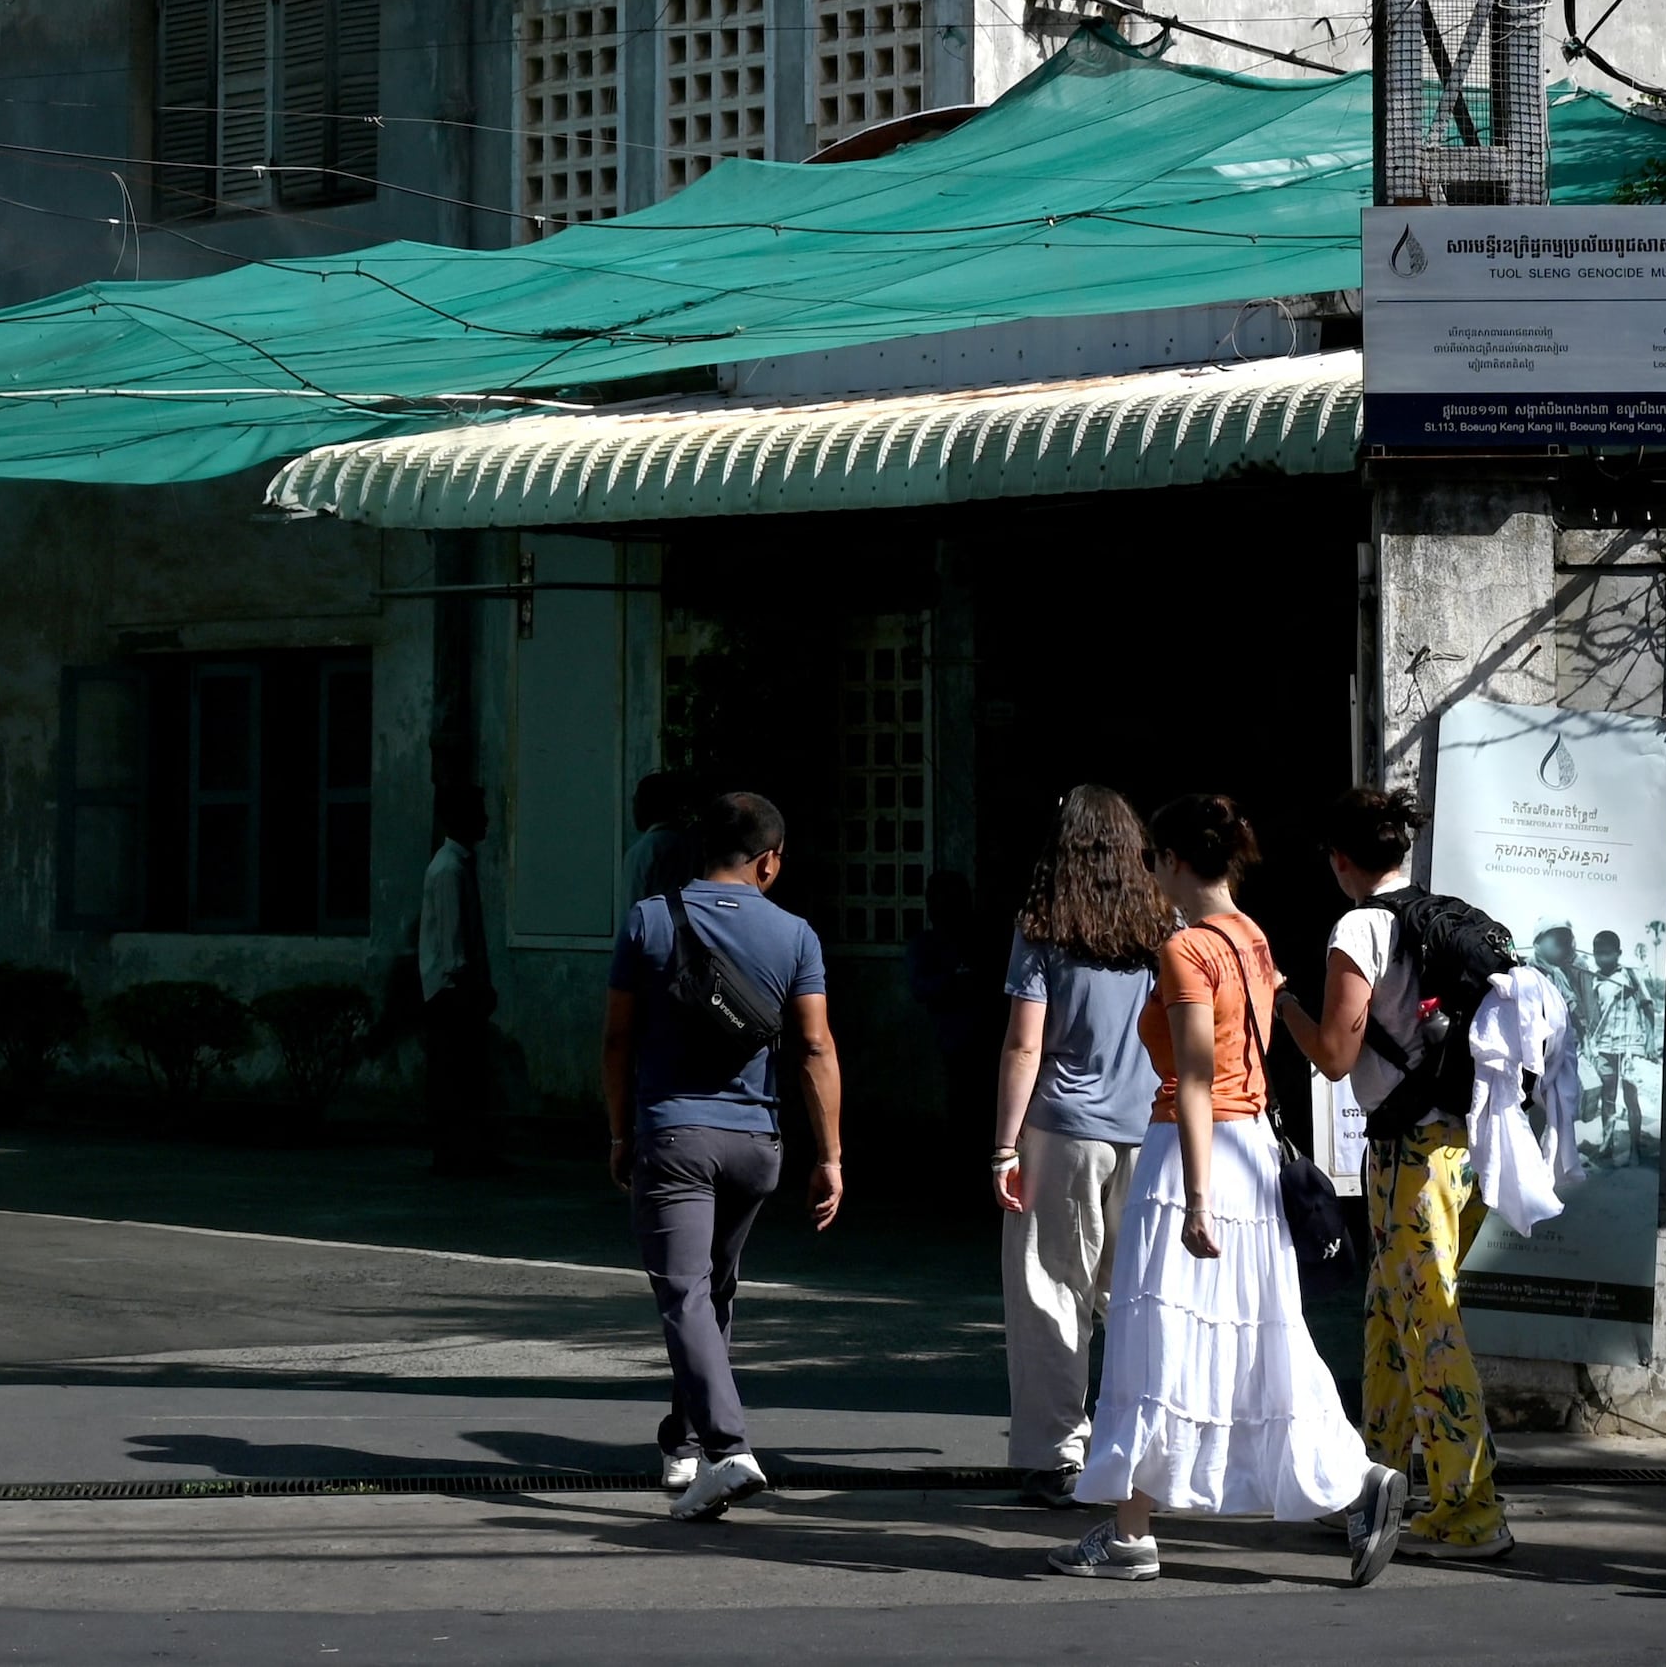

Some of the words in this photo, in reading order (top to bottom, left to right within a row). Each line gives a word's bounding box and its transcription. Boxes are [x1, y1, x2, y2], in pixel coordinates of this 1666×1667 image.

[1489, 268, 1522, 279] TUOL
[1528, 268, 1571, 279] SLENG
[1577, 267, 1644, 278] GENOCIDE
[1424, 421, 1458, 433] St.113,
[1460, 421, 1497, 434] Boeung
[1499, 421, 1525, 434] Keng
[1527, 421, 1553, 434] Kang
[1569, 421, 1607, 433] Boeung
[1609, 421, 1635, 433] Keng
[1637, 421, 1666, 433] Kang,
[1499, 817, 1516, 825] THE
[1517, 818, 1563, 830] TEMPORARY
[1564, 821, 1610, 833] EXHIBITION
[1484, 863, 1541, 875] CHILDHOOD
[1542, 868, 1585, 880] WITHOUT
[1587, 870, 1619, 883] COLOR
[1343, 1131, 1357, 1140] NO
